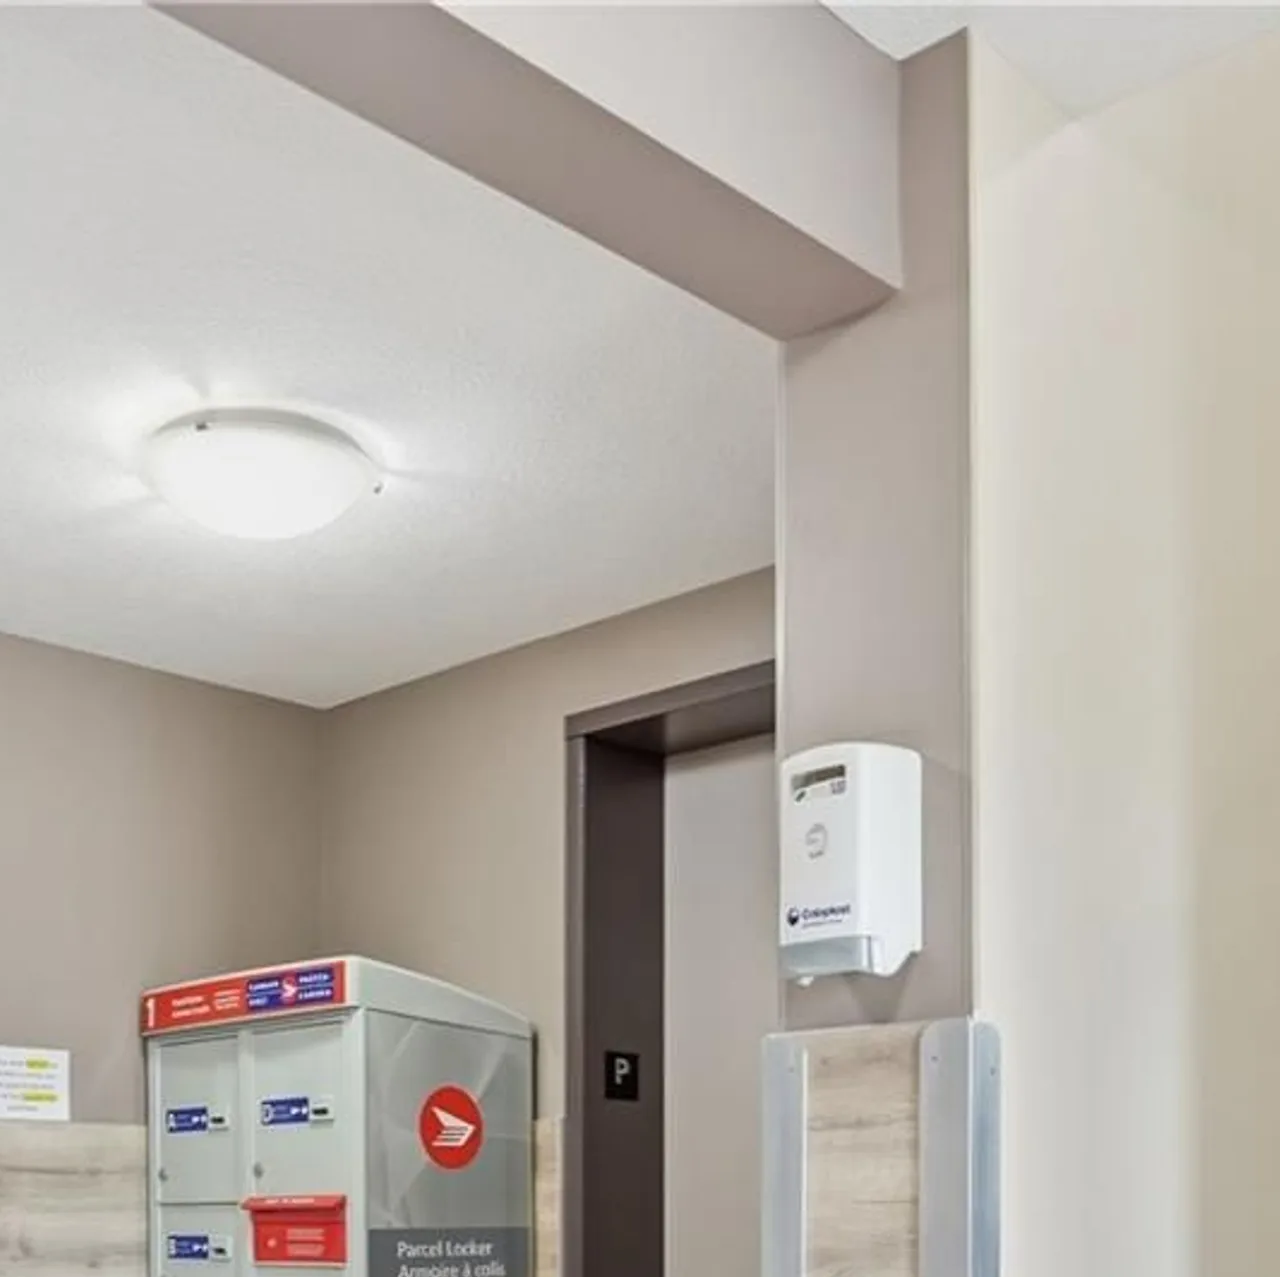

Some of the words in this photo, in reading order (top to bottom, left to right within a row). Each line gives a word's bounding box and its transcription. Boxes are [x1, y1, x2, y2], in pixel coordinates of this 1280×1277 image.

[615, 1057, 631, 1085] P
[397, 1240, 442, 1258] Parcel
[445, 1239, 493, 1257] Locker
[474, 1259, 506, 1277] colis
